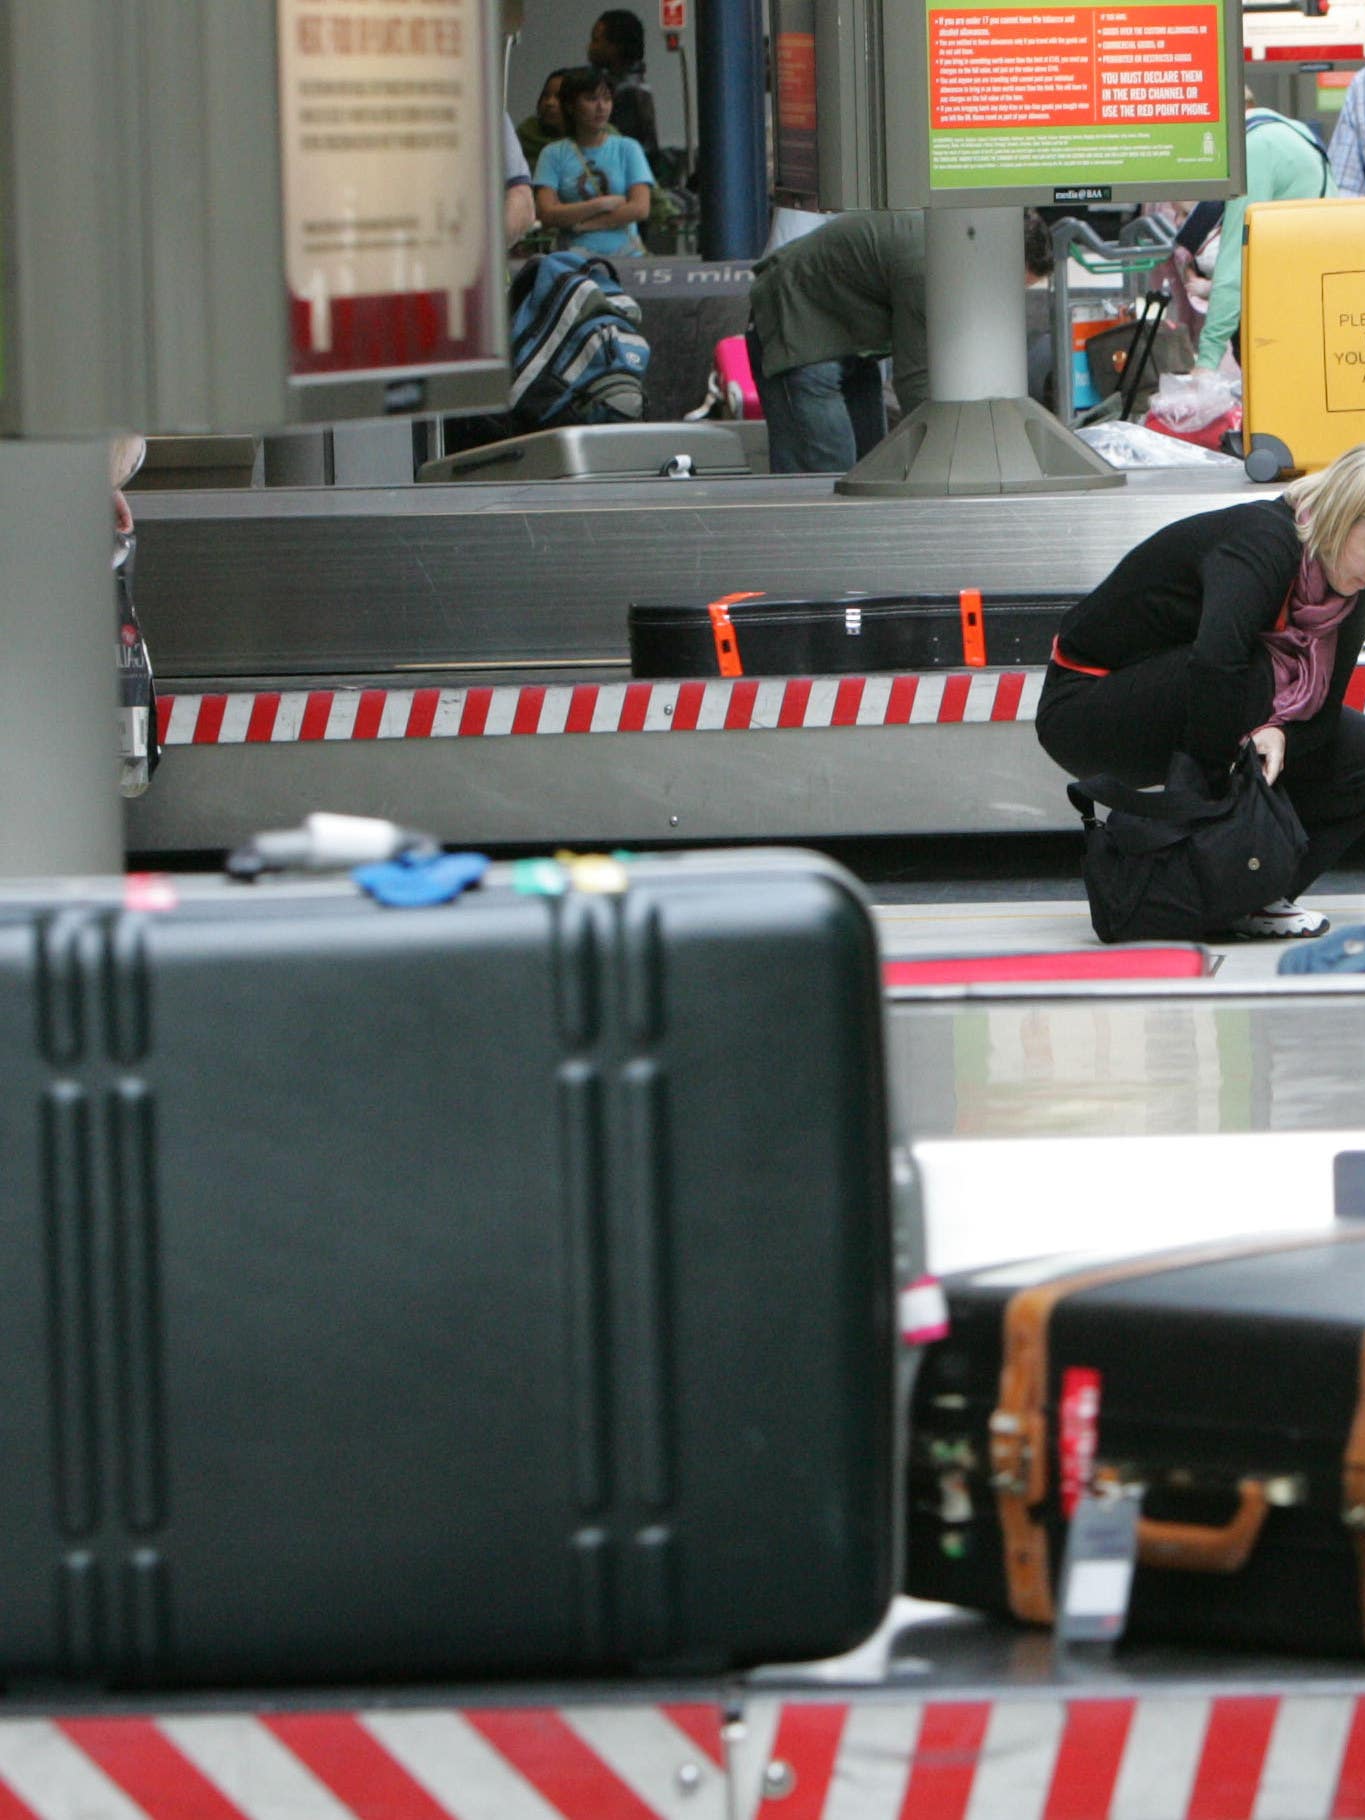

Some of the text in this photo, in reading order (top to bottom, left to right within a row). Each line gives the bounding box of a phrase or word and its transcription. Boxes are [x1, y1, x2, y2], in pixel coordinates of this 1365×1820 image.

[1101, 70, 1203, 84] YOU MUST DECLARE THEM
[1112, 88, 1128, 101] THE
[1130, 88, 1147, 100] RED
[1148, 87, 1185, 100] CHANNEL
[1102, 105, 1118, 118] USE
[1120, 104, 1136, 117] THE
[1137, 104, 1153, 116] RED
[1155, 103, 1180, 116] POINT
[632, 268, 673, 285] 15
